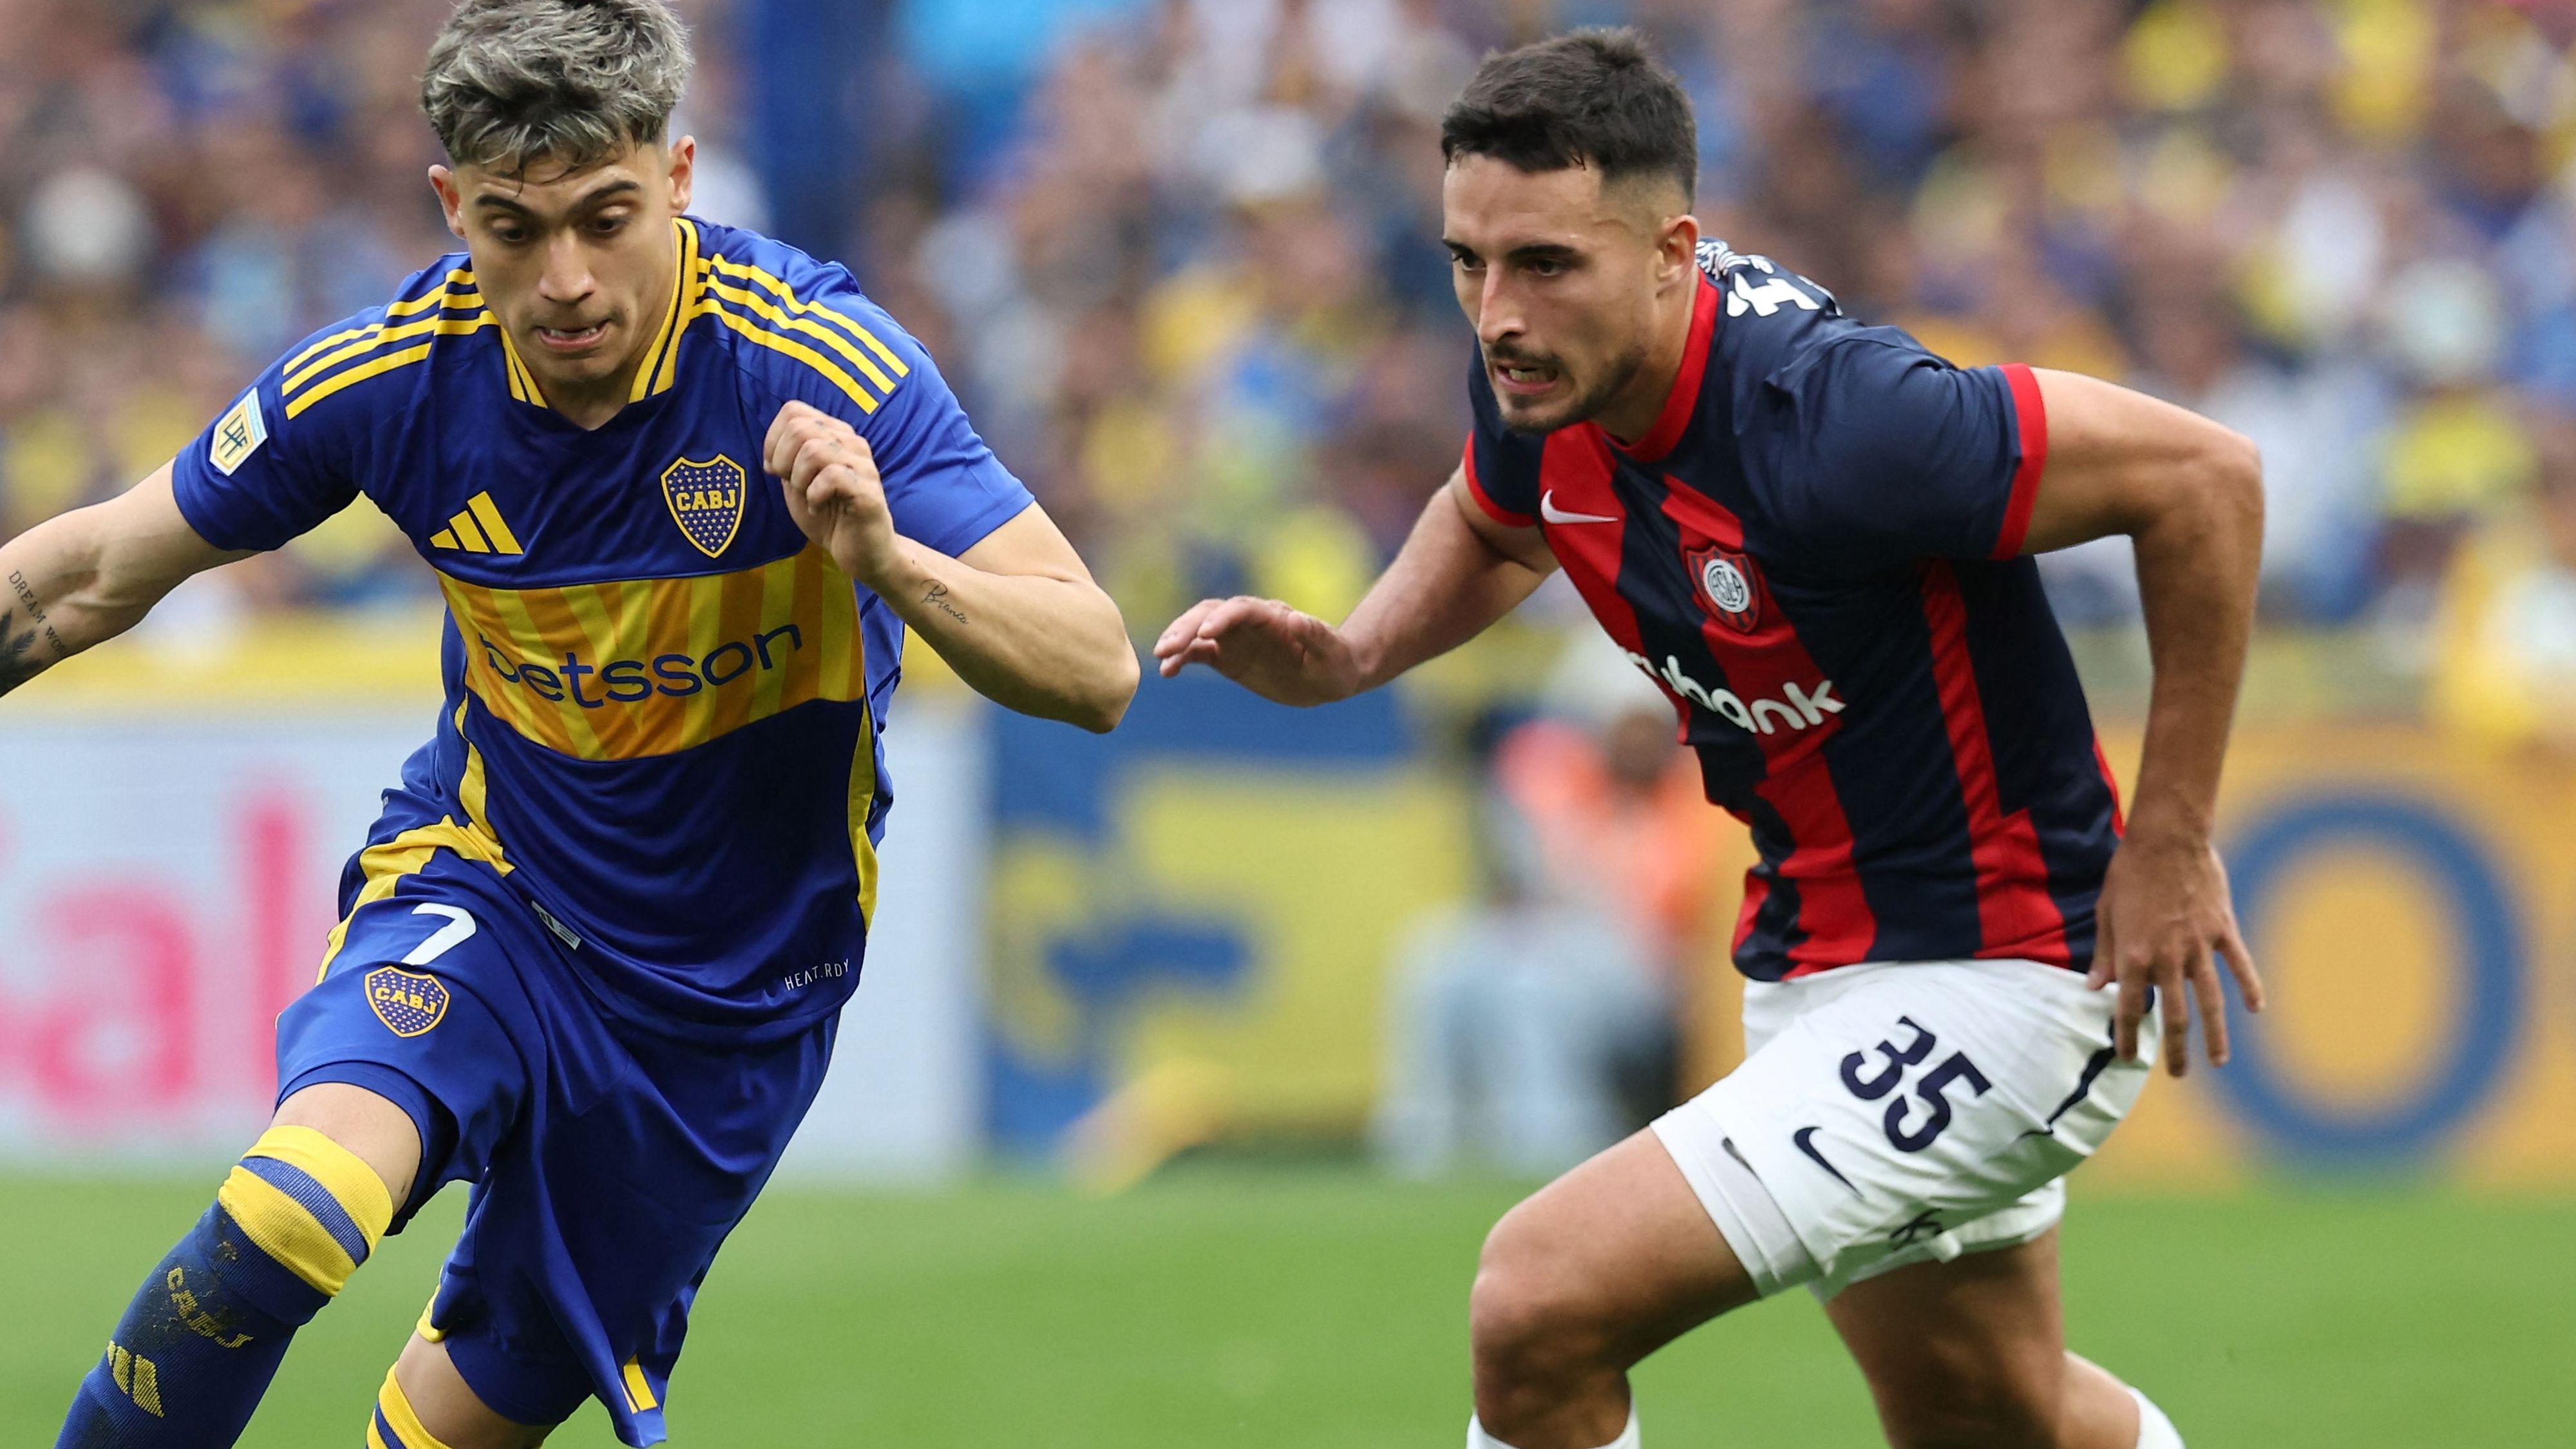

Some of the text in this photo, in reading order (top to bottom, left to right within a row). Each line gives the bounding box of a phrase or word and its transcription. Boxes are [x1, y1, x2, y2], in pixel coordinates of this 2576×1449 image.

[676, 489, 736, 511] CABJ
[9, 570, 46, 624] DREAM
[478, 623, 802, 708] betsson
[400, 902, 477, 966] 7
[375, 987, 437, 1015] CABJ
[784, 958, 849, 991] HEAT.RDY
[1839, 1015, 1993, 1153] 35
